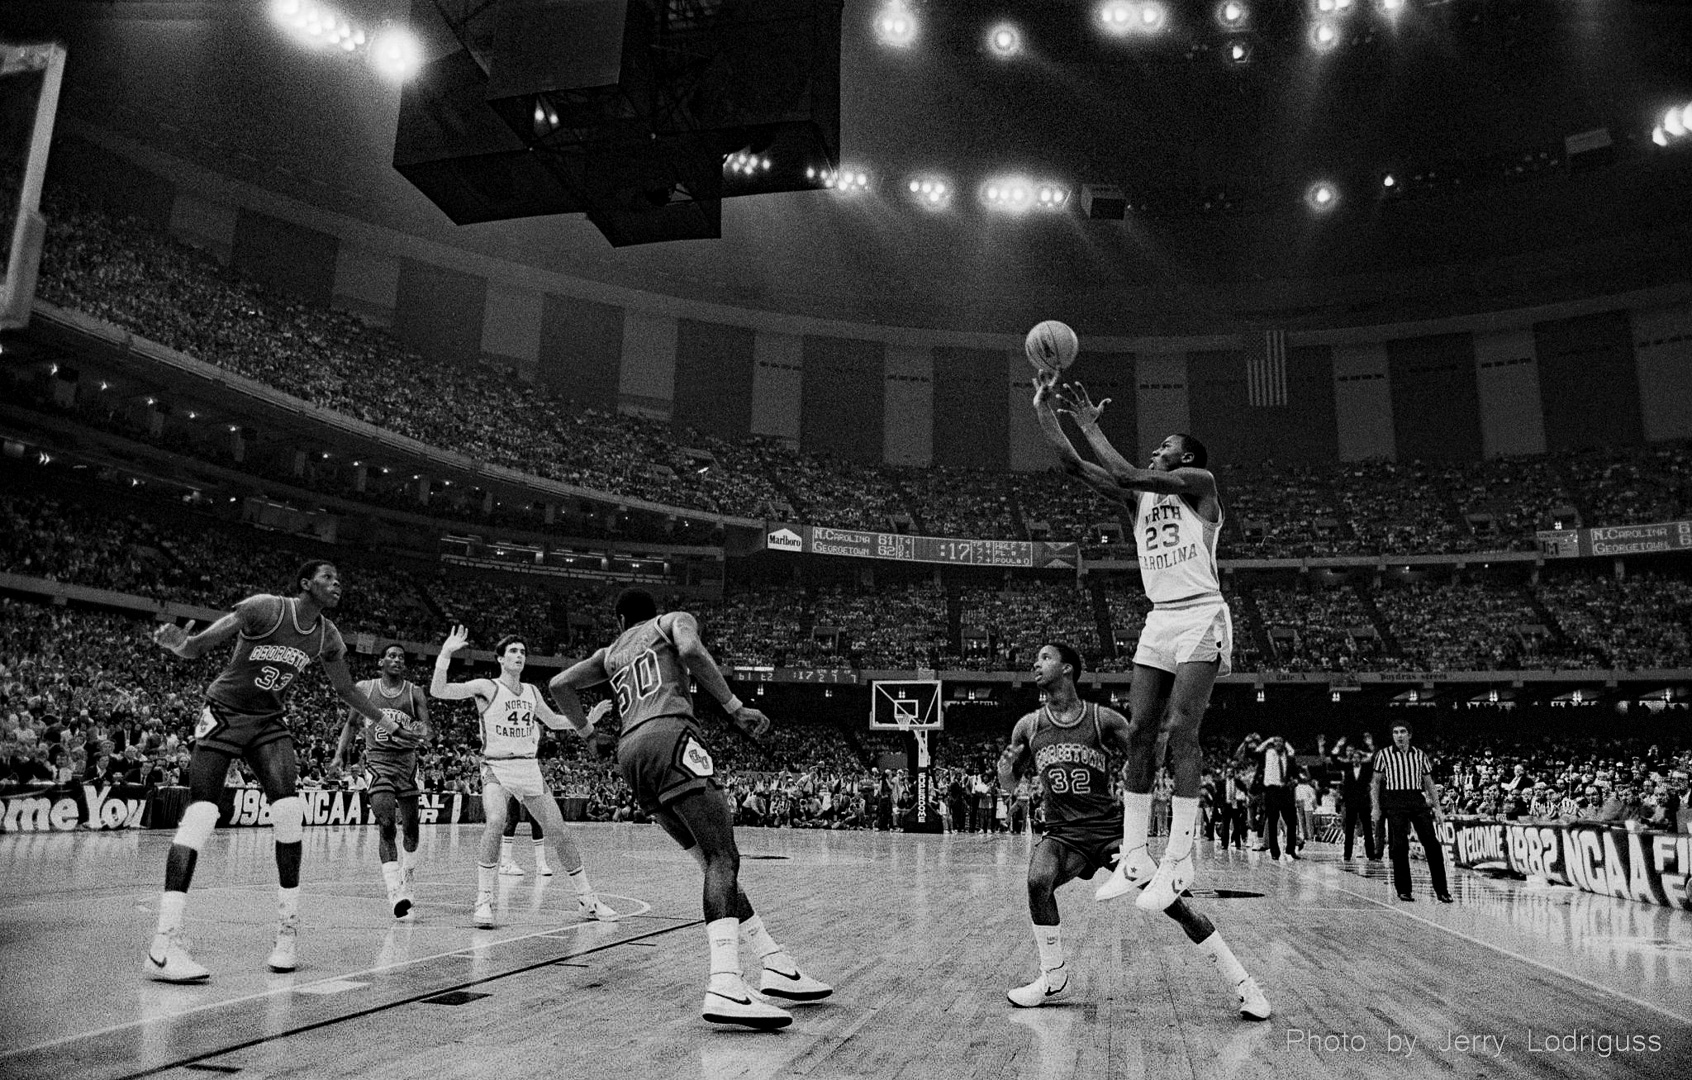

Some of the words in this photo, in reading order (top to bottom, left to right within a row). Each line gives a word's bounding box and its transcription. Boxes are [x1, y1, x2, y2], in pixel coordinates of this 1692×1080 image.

[768, 535, 801, 547] Marlboro
[1145, 523, 1180, 551] 23
[254, 665, 294, 691] 33
[609, 648, 662, 717] 50
[505, 699, 533, 712] NORTH
[507, 711, 531, 726] 44
[1048, 768, 1091, 794] 32
[0, 797, 79, 831] me
[83, 785, 147, 829] You
[229, 788, 276, 825] 198
[300, 791, 361, 825] NCAA
[1456, 824, 1504, 864] WELCOME
[1506, 825, 1571, 886] 1982
[1562, 829, 1660, 905] NCAA
